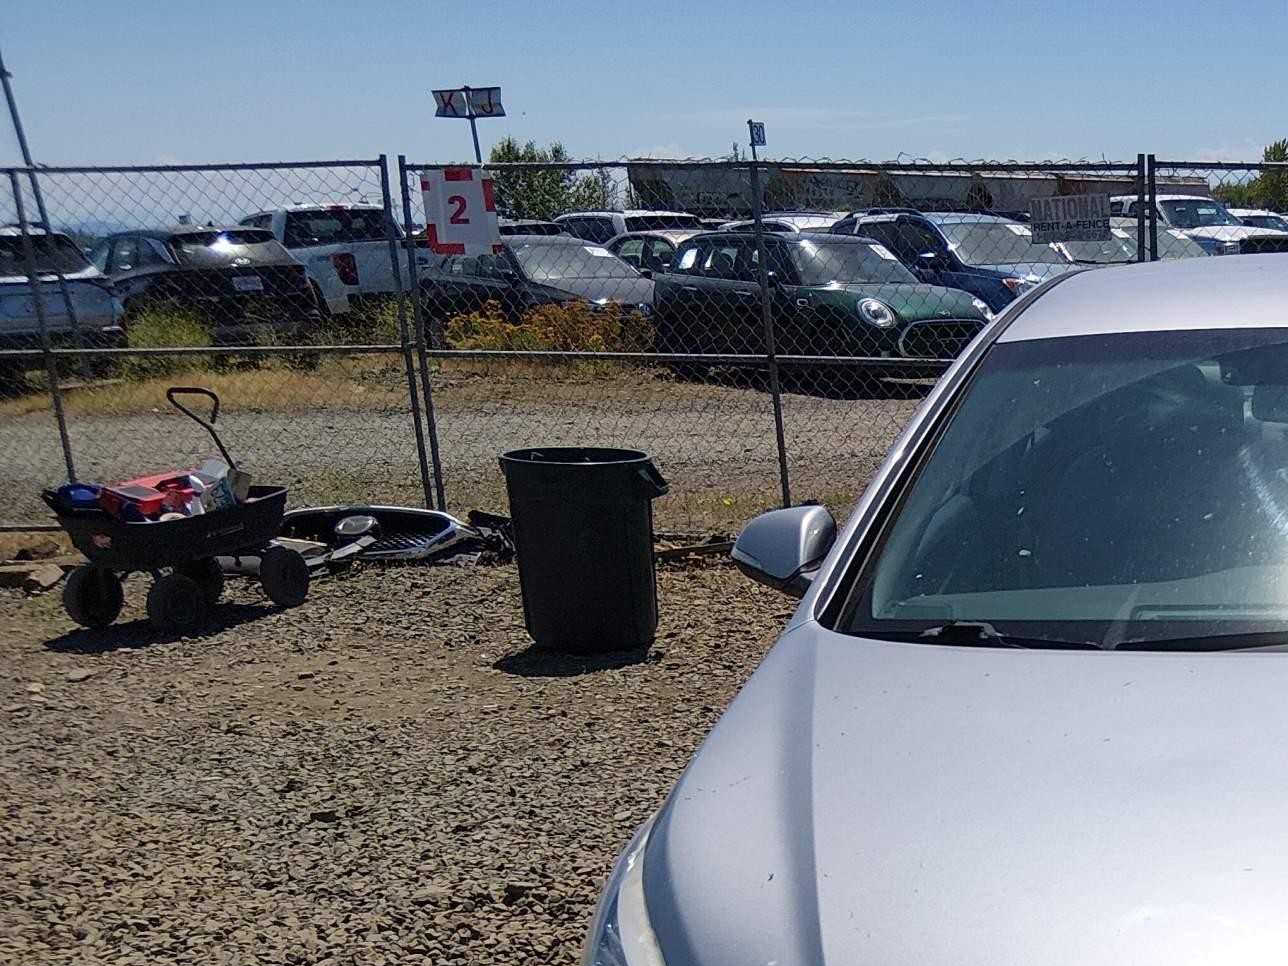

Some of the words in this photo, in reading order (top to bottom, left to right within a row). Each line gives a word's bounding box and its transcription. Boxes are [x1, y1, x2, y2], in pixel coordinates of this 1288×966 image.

[440, 92, 457, 115] K
[481, 89, 493, 114] J
[447, 195, 470, 225] 2
[1031, 195, 1108, 221] NATIONAL
[1033, 219, 1109, 233] RENT-A-FENCE
